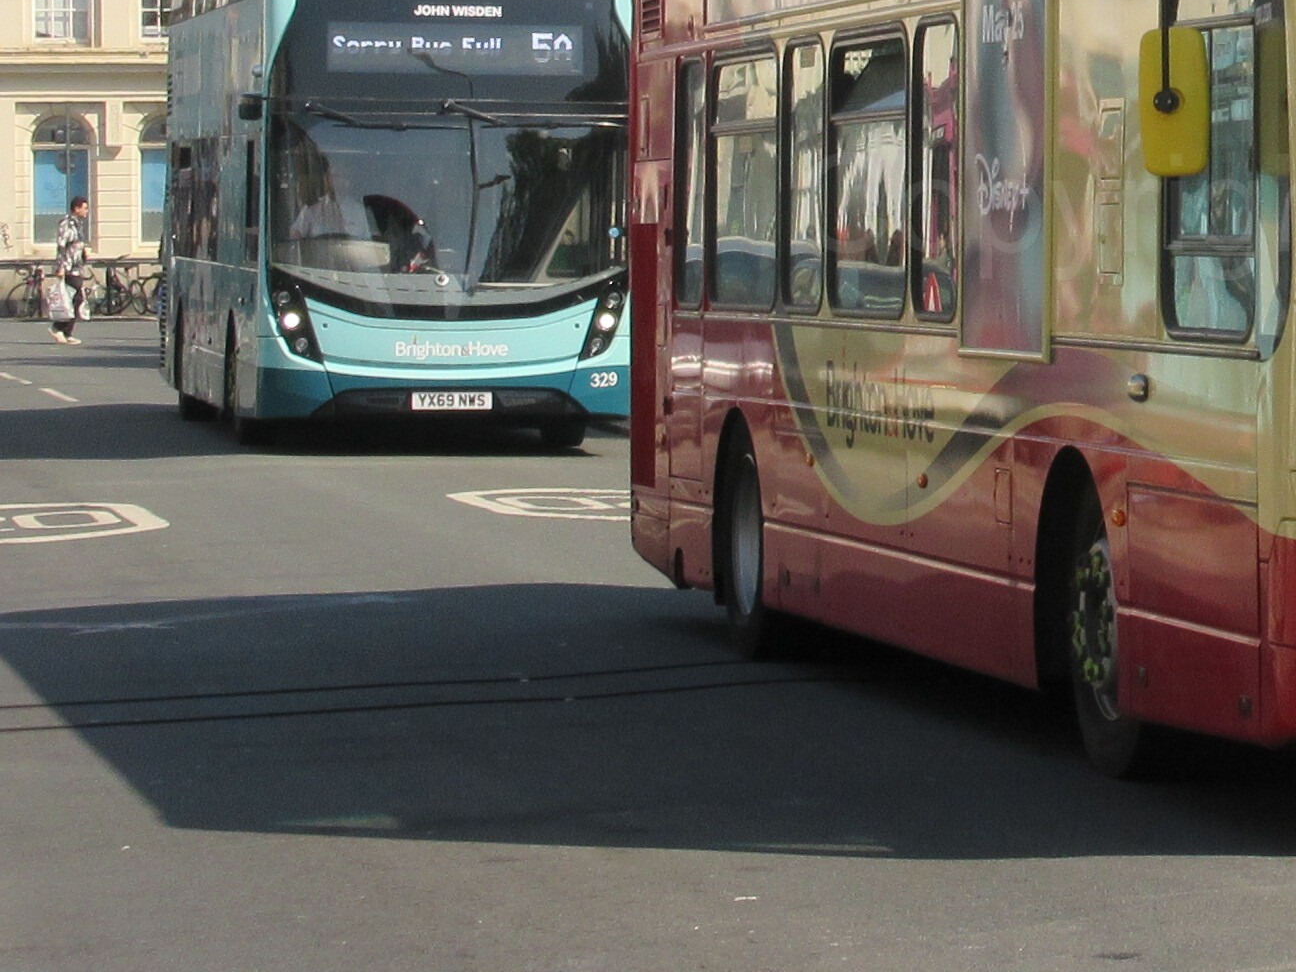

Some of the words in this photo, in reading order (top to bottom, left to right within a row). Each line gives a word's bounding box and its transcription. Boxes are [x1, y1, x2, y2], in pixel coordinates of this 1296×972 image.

[413, 4, 450, 17] JOHN
[451, 5, 503, 18] WISDEN
[590, 371, 618, 389] 329
[418, 393, 456, 408] YX69
[458, 393, 487, 408] NWS
